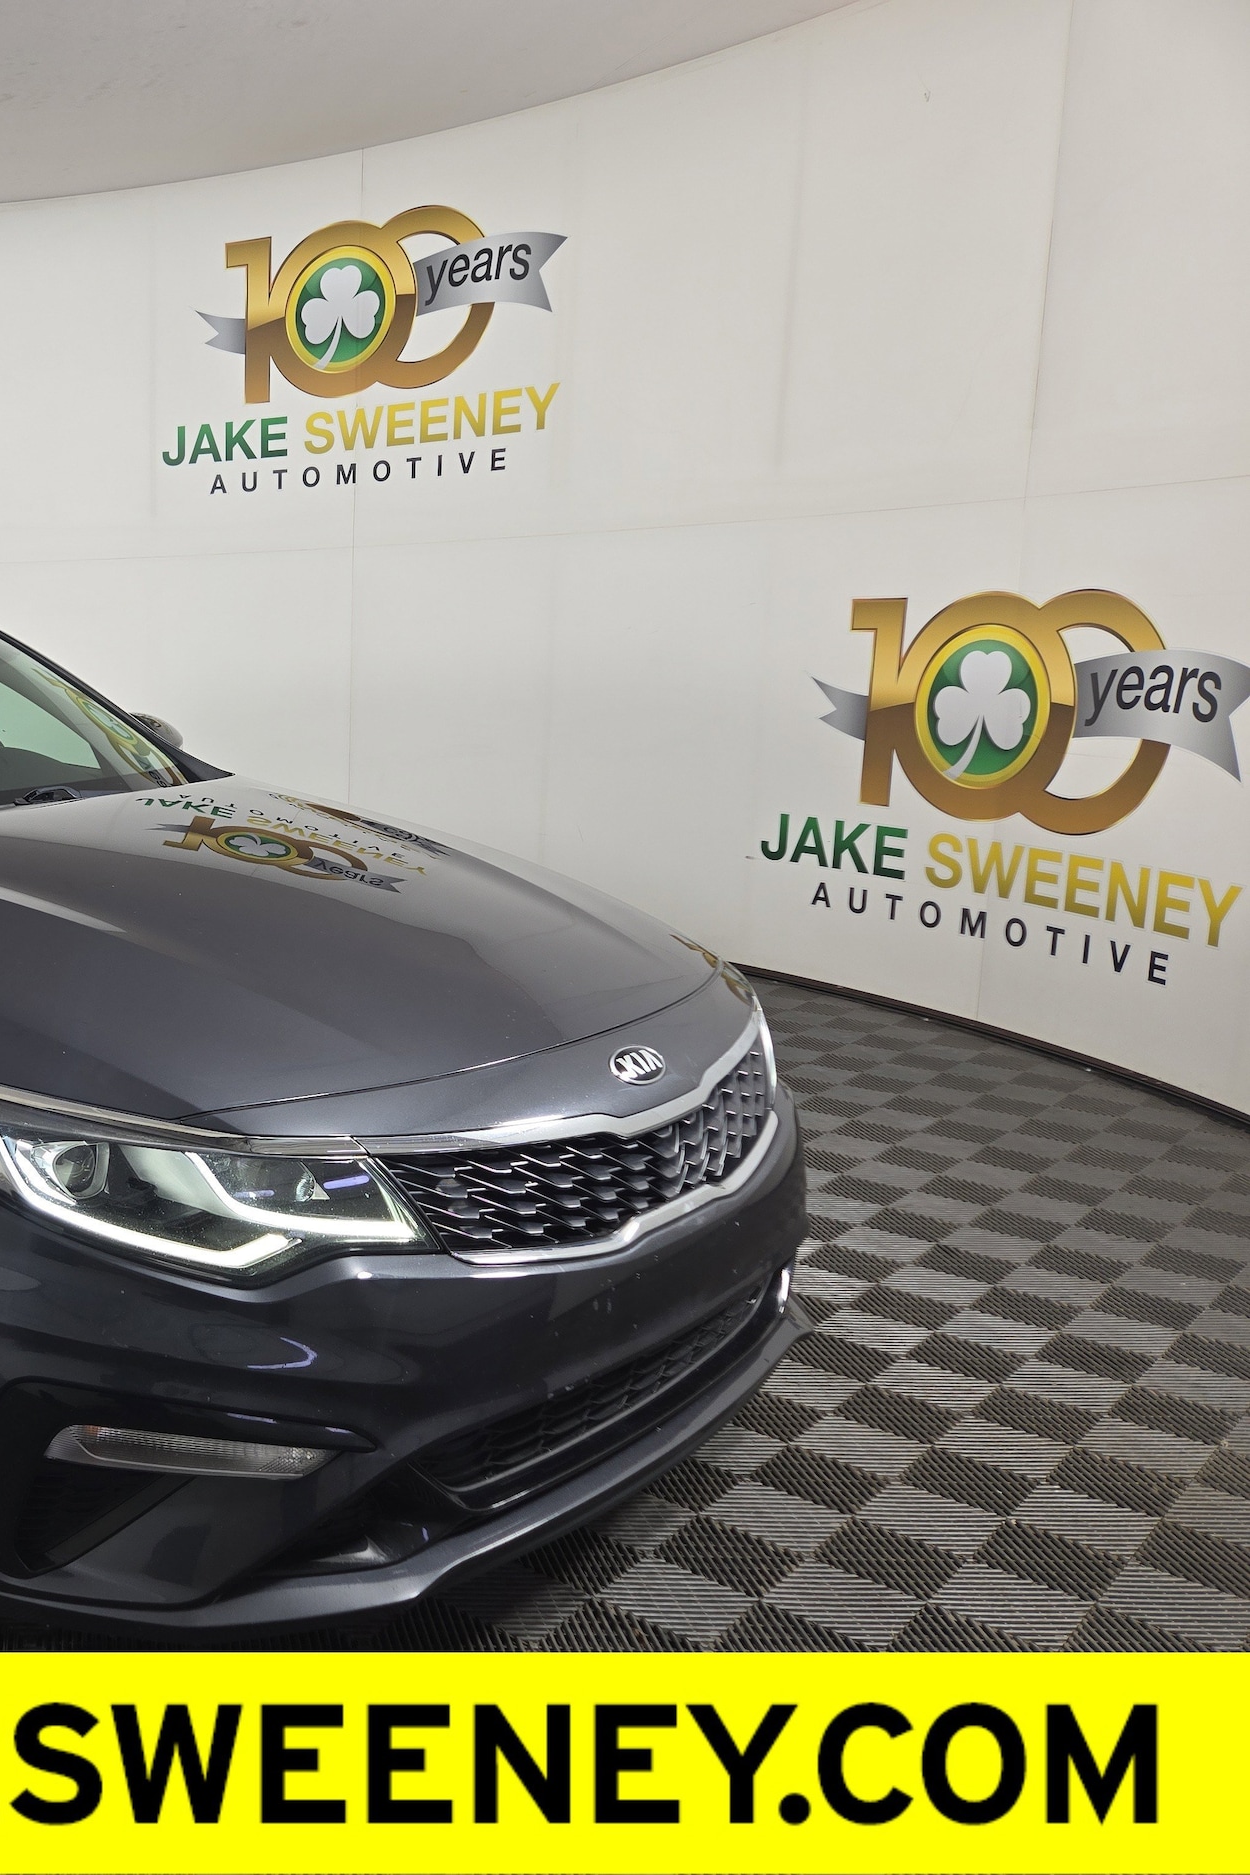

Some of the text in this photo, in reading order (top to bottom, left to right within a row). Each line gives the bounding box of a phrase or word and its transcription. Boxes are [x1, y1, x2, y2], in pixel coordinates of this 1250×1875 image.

[225, 205, 496, 404] 100
[424, 243, 532, 306] years
[162, 382, 561, 466] JAKE SWEENEY
[210, 448, 507, 494] AUTOMOTIVE
[851, 589, 1171, 835] 100
[1084, 664, 1223, 727] years
[761, 813, 1243, 947] JAKE SWEENEY
[812, 882, 1169, 985] AUTOMOTIVE
[615, 1049, 664, 1079] KIA
